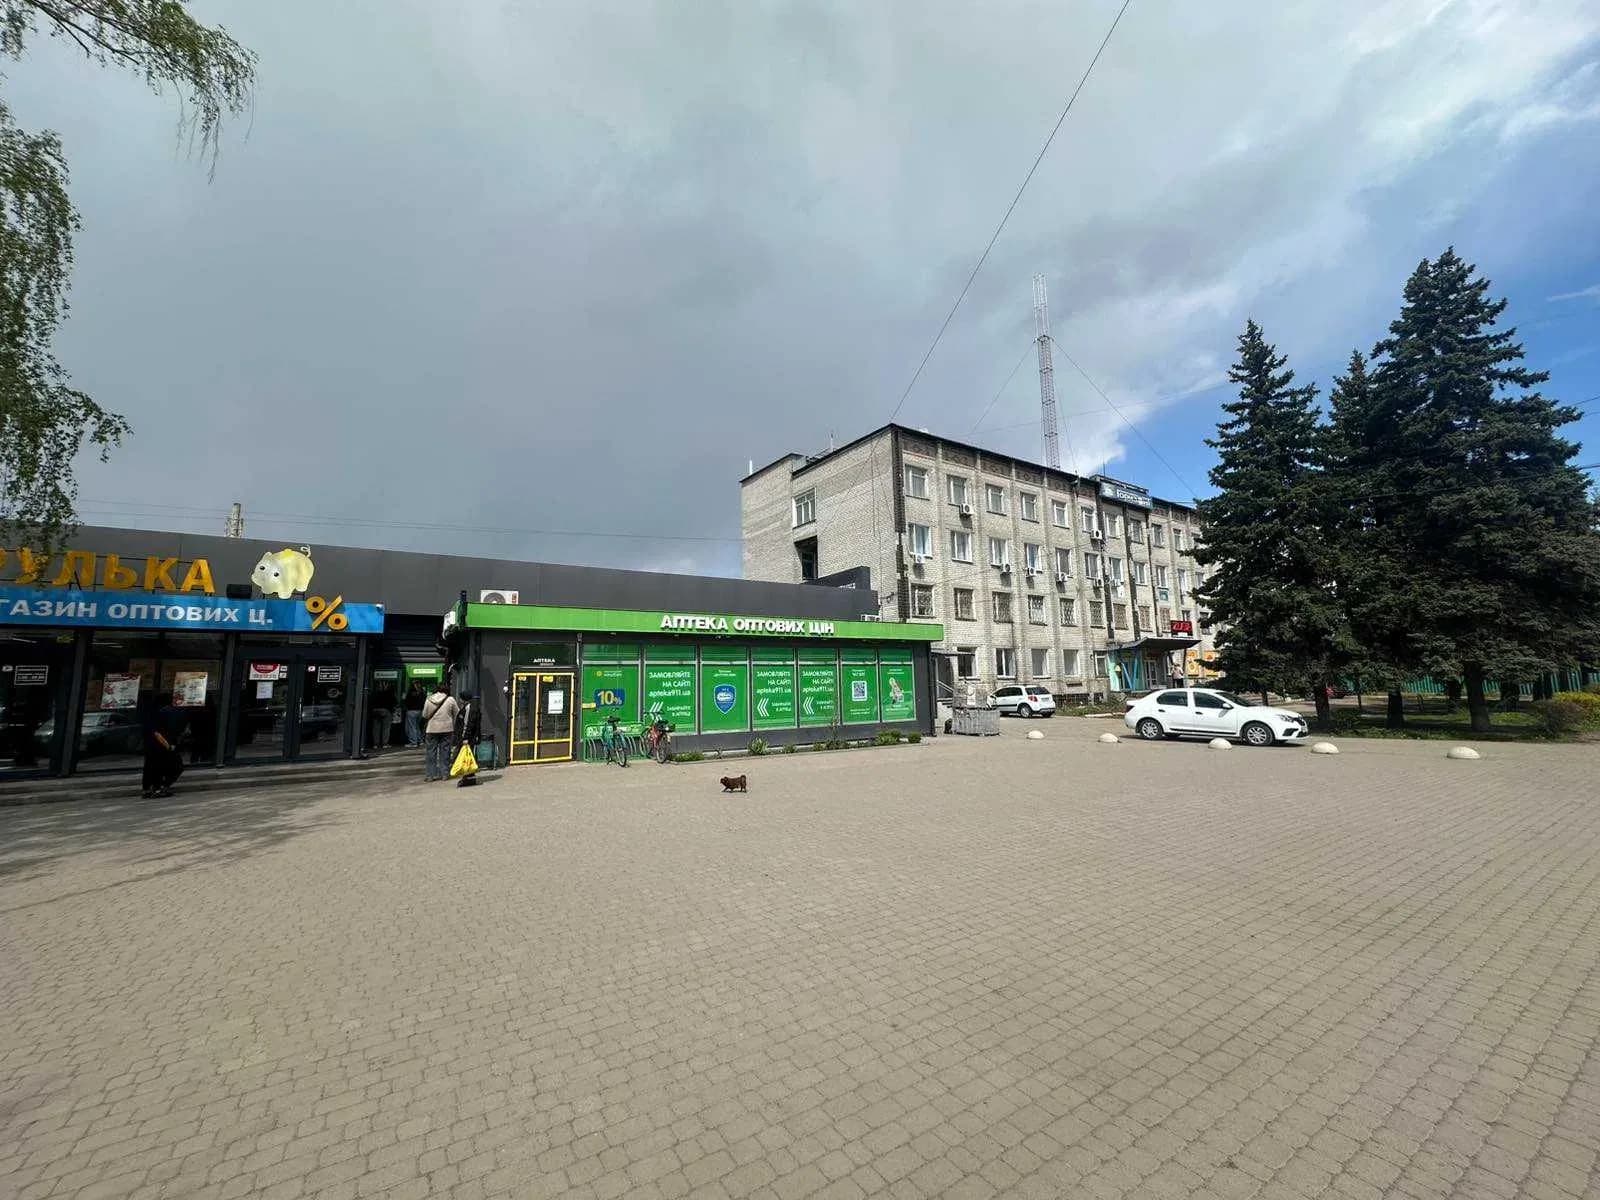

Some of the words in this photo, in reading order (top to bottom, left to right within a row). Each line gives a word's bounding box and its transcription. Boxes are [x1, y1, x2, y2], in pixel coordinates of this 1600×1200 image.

[0, 546, 216, 594] УЛЬКА
[107, 603, 240, 623] ОПТОВИХ
[249, 608, 273, 626] Ц.
[659, 614, 729, 632] АПТЕКА
[733, 618, 805, 635] ОПТОВИХ
[809, 622, 835, 637] ЦІН
[648, 670, 691, 679] ЗАМОВЛЯЙТЕ
[597, 690, 623, 706] 10%
